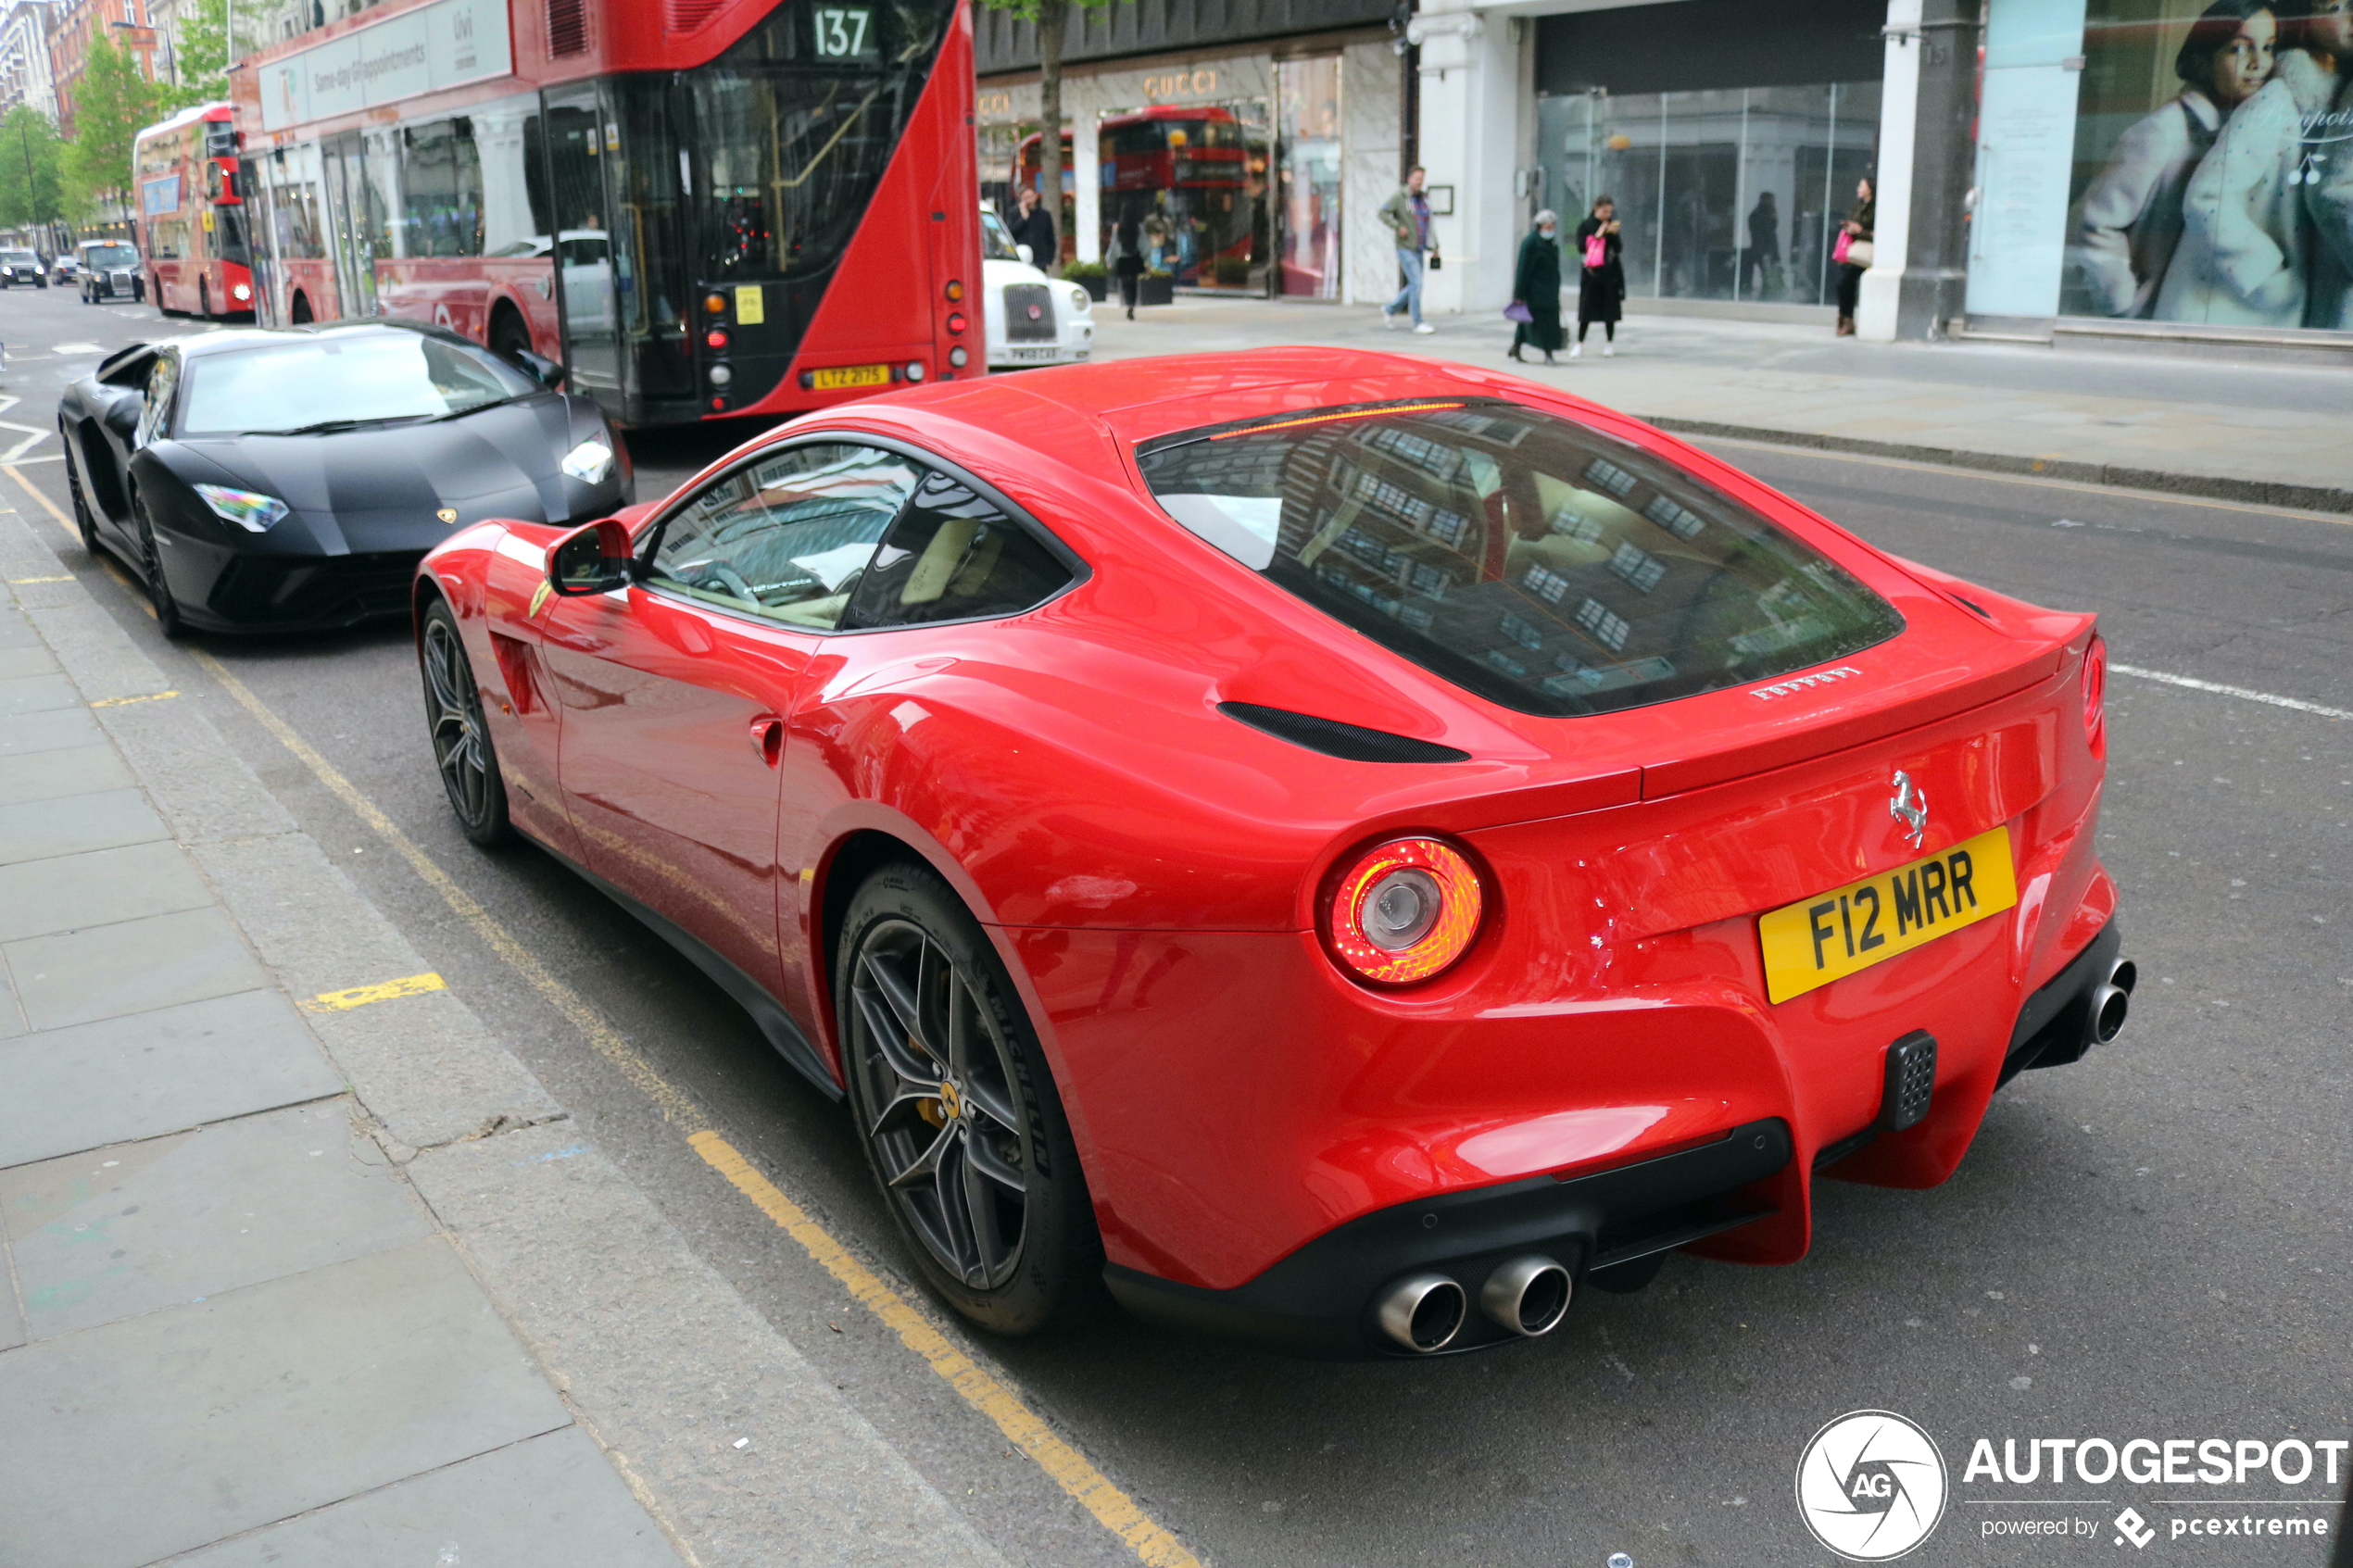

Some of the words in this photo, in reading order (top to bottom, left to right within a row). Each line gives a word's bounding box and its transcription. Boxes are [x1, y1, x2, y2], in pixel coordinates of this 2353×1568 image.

[815, 8, 869, 56] 137
[363, 42, 426, 85] appointments
[1143, 69, 1216, 99] GUCCI
[977, 94, 1010, 117] CCI
[820, 370, 847, 386] LTZ
[1748, 666, 1863, 701] Ferrari
[1808, 884, 1885, 971] F12
[1892, 850, 1978, 937] MRR
[989, 995, 1050, 1172] MICHELIN
